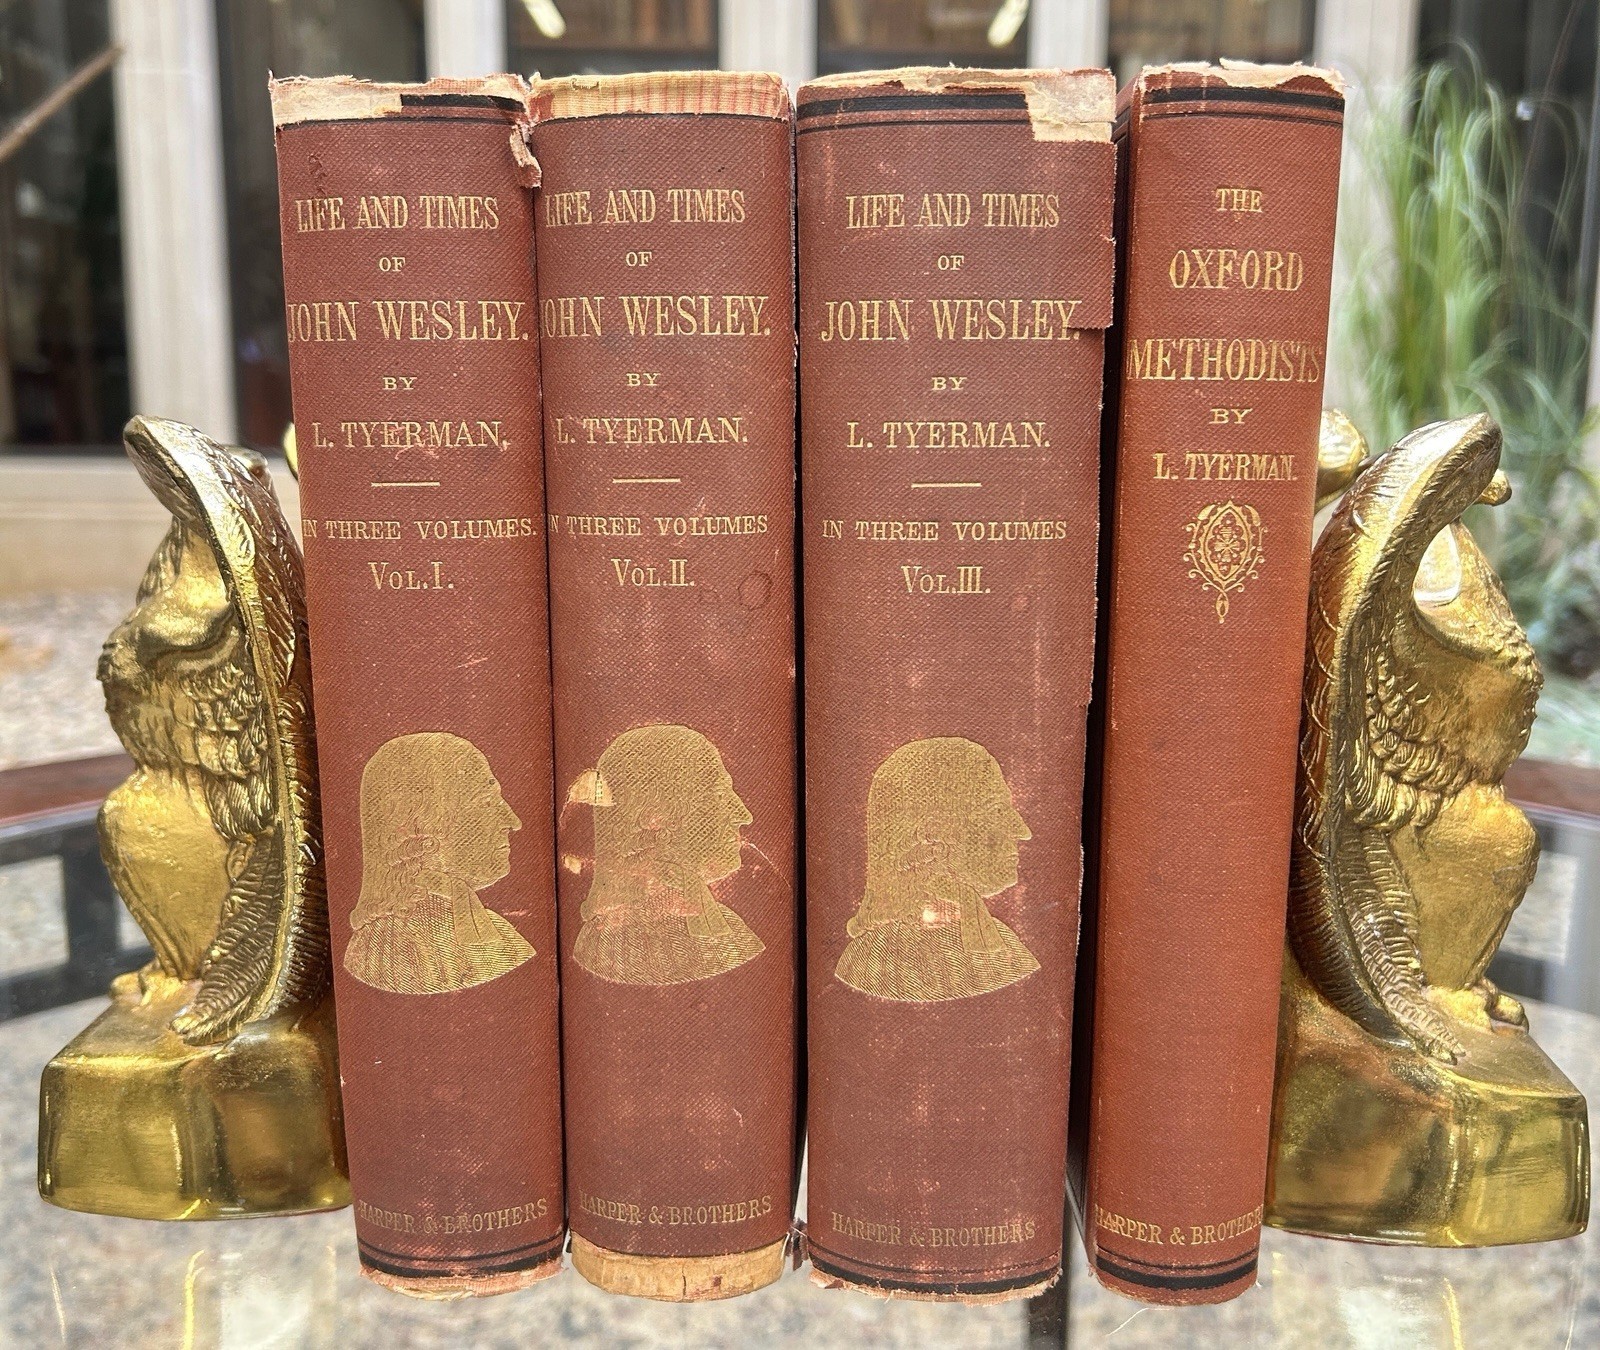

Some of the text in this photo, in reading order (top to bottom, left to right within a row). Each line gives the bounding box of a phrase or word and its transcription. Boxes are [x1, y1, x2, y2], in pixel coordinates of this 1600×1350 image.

[295, 194, 500, 232] LIFE AND TIMES
[540, 188, 746, 228] LIFE AND TIMES
[846, 193, 1060, 229] LIFE AND TIMES
[1215, 188, 1263, 213] THE
[378, 257, 406, 272] OF
[625, 251, 653, 267] OF
[937, 255, 965, 271] OF
[1169, 249, 1303, 291] OXFORD
[287, 300, 529, 342] JOHN WESLEY.
[618, 295, 771, 337] WESLEY.
[821, 299, 1082, 342] JOHN WESLEY.
[1127, 338, 1322, 383] METHODISTS
[382, 376, 418, 391] BY
[626, 373, 661, 387] BY
[931, 376, 968, 391] BY
[556, 417, 748, 444] L. TYERMAN.
[1209, 408, 1253, 425] BY
[312, 420, 510, 450] L. TYERMAN.
[846, 421, 1051, 448] L. TYERMAN.
[1152, 452, 1299, 482] L. TYERMAN.
[325, 520, 402, 540] THREE
[413, 517, 538, 540] VOLUMES.
[566, 514, 642, 536] THREE
[654, 514, 769, 536] VOLUMES
[822, 520, 1068, 541] IN THREE VOLUMES
[357, 1197, 549, 1235] HARPER & BROTHERS
[578, 1190, 773, 1226] HARPER & BROTHERS
[831, 1211, 1037, 1247] HARPER & BROTHERS
[1094, 1203, 1264, 1246] HARPER & BROTHER
